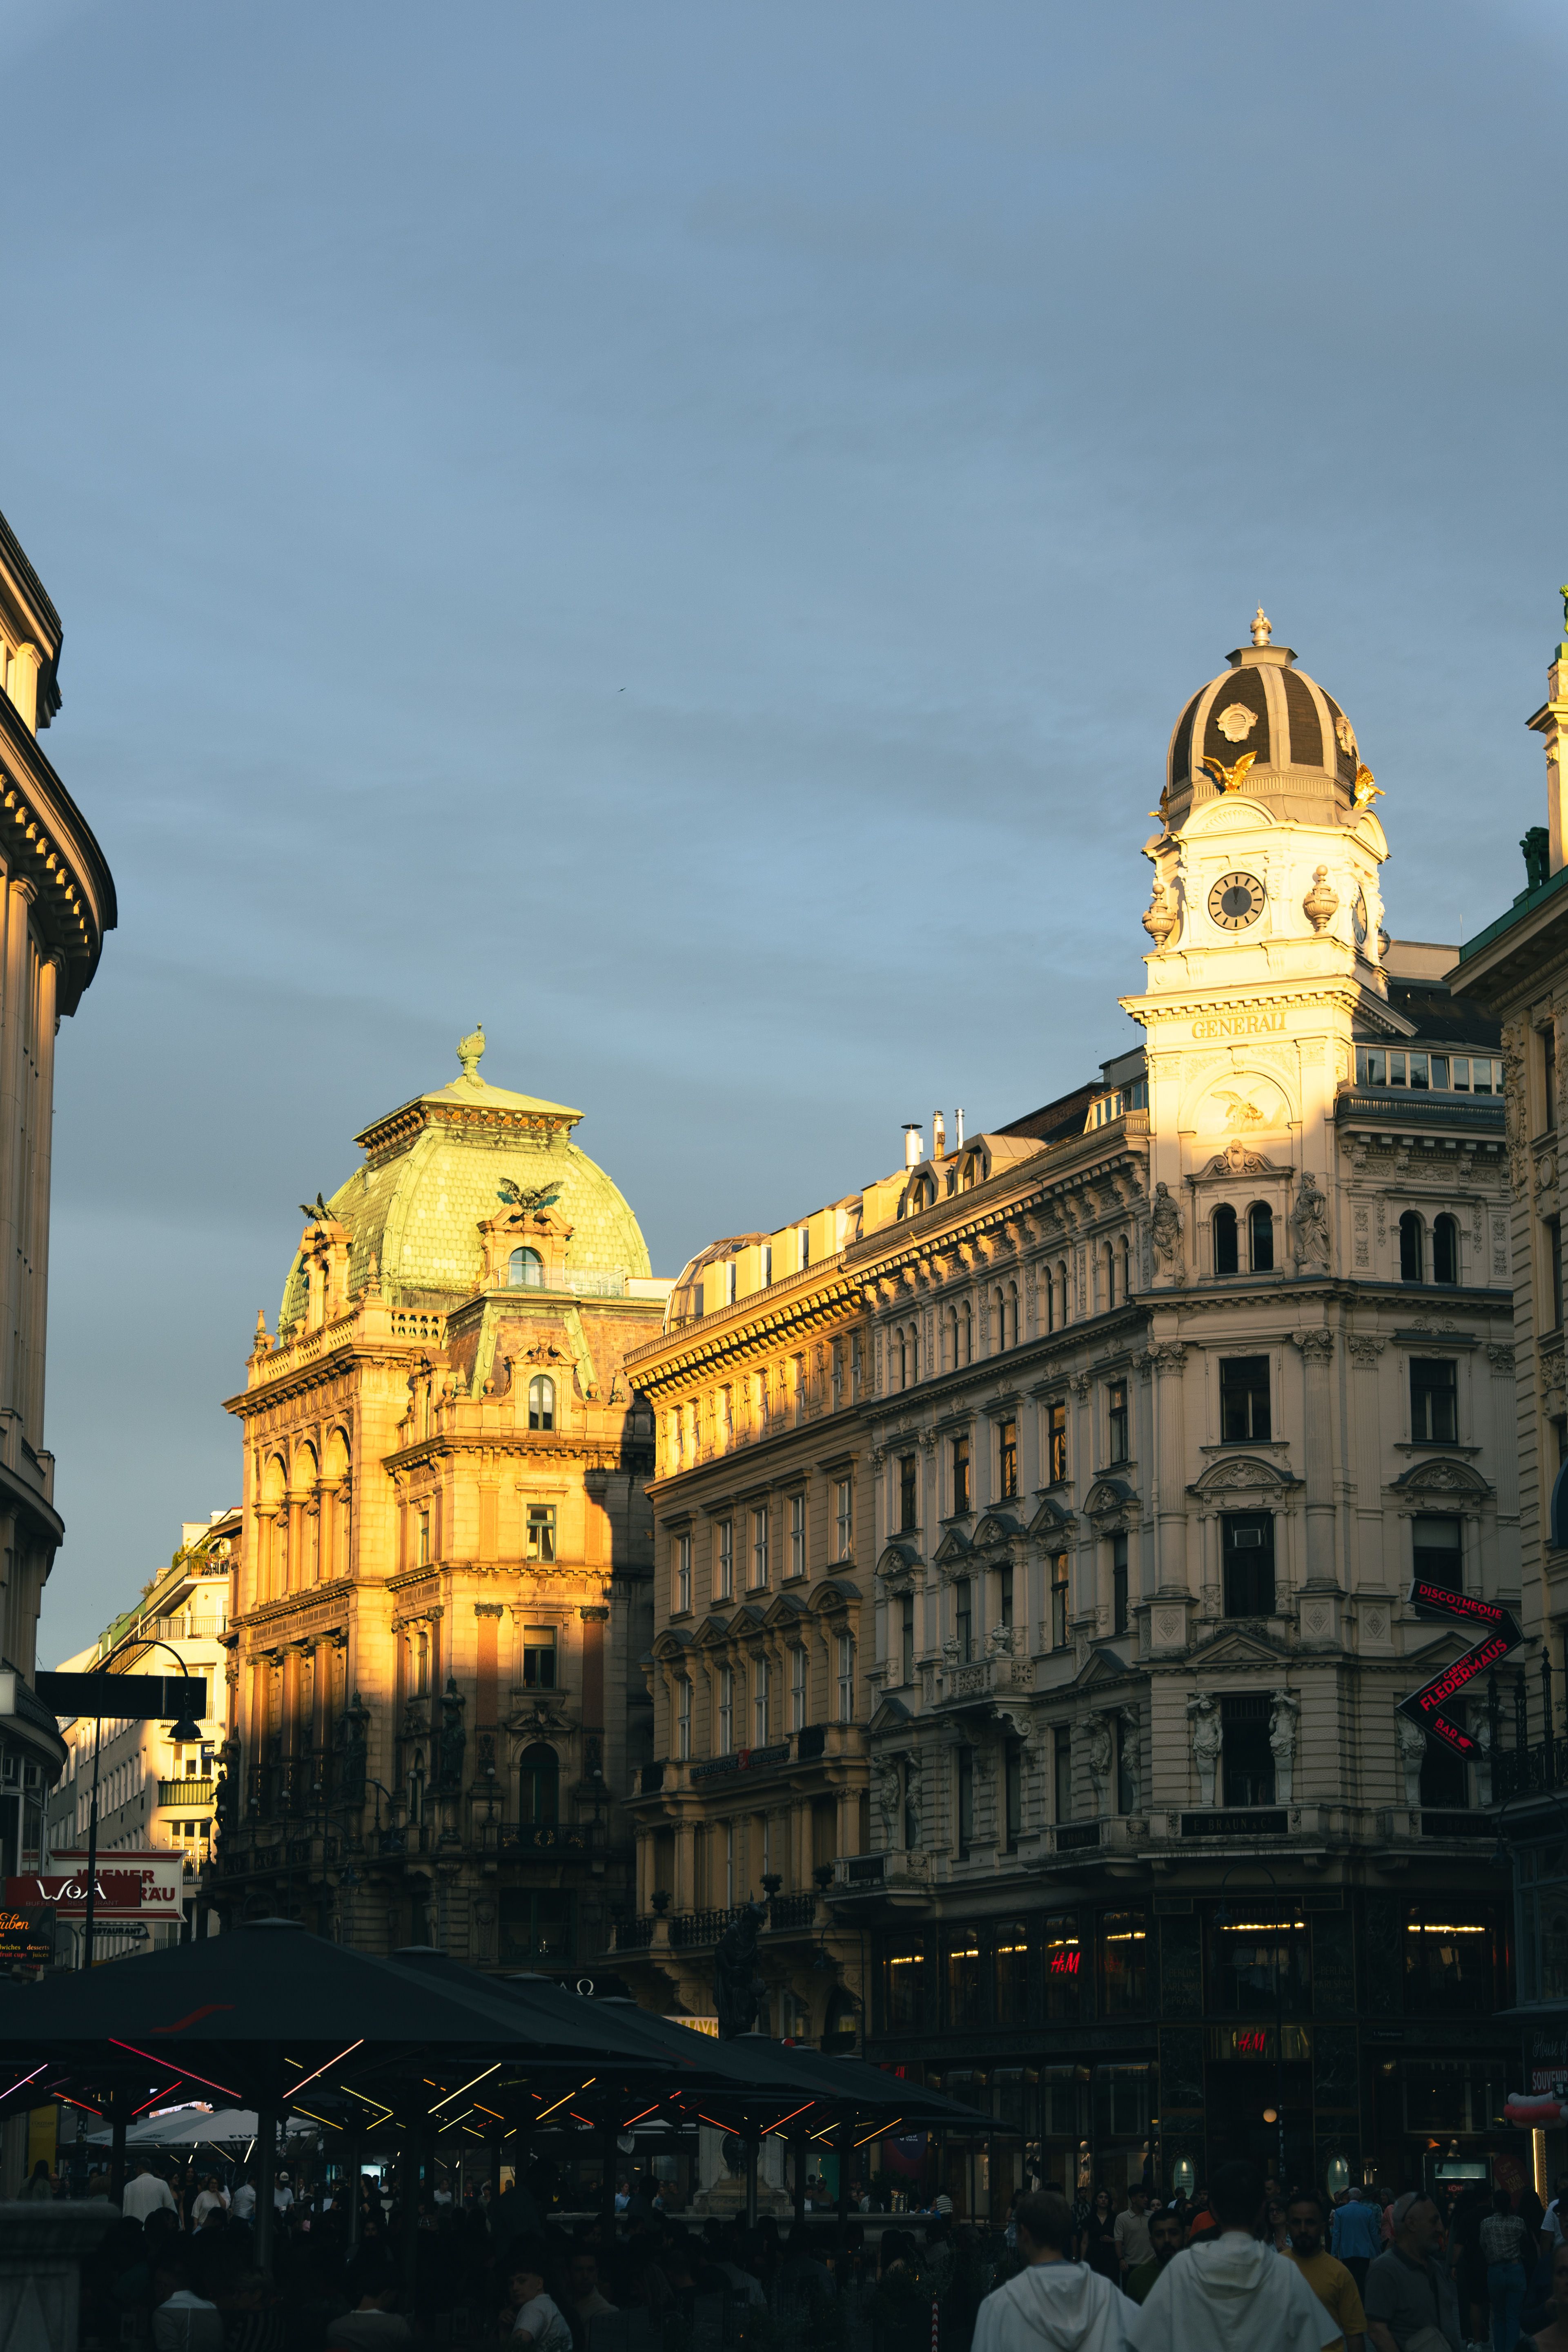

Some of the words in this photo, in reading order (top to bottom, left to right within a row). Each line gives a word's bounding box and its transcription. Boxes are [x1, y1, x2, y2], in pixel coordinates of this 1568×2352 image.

[1192, 1013, 1287, 1038] GENERALI
[1419, 1584, 1503, 1619] DISCOTHEQUE
[1443, 1654, 1472, 1679] CABARET
[1420, 1639, 1507, 1711] FLEDERMAUS
[1435, 1718, 1458, 1739] BAR
[1194, 1820, 1203, 1831] E.
[1208, 1818, 1247, 1831] BRAUN
[1433, 1819, 1442, 1831] E.
[1447, 1819, 1483, 1832] BRAUN
[1067, 1831, 1085, 1845] BRAUN
[1051, 1952, 1081, 1974] H&M
[1169, 1968, 1194, 1978] BERLIN
[1320, 1966, 1347, 1976] BERLIN
[1163, 1982, 1201, 1992] KARLSBAD
[1314, 1980, 1354, 1989] KARLSBAD
[1172, 1996, 1194, 2005] PRAG
[1323, 1994, 1345, 2003] PRAG
[1238, 2033, 1265, 2052] H&M
[1532, 2031, 1559, 2059] House
